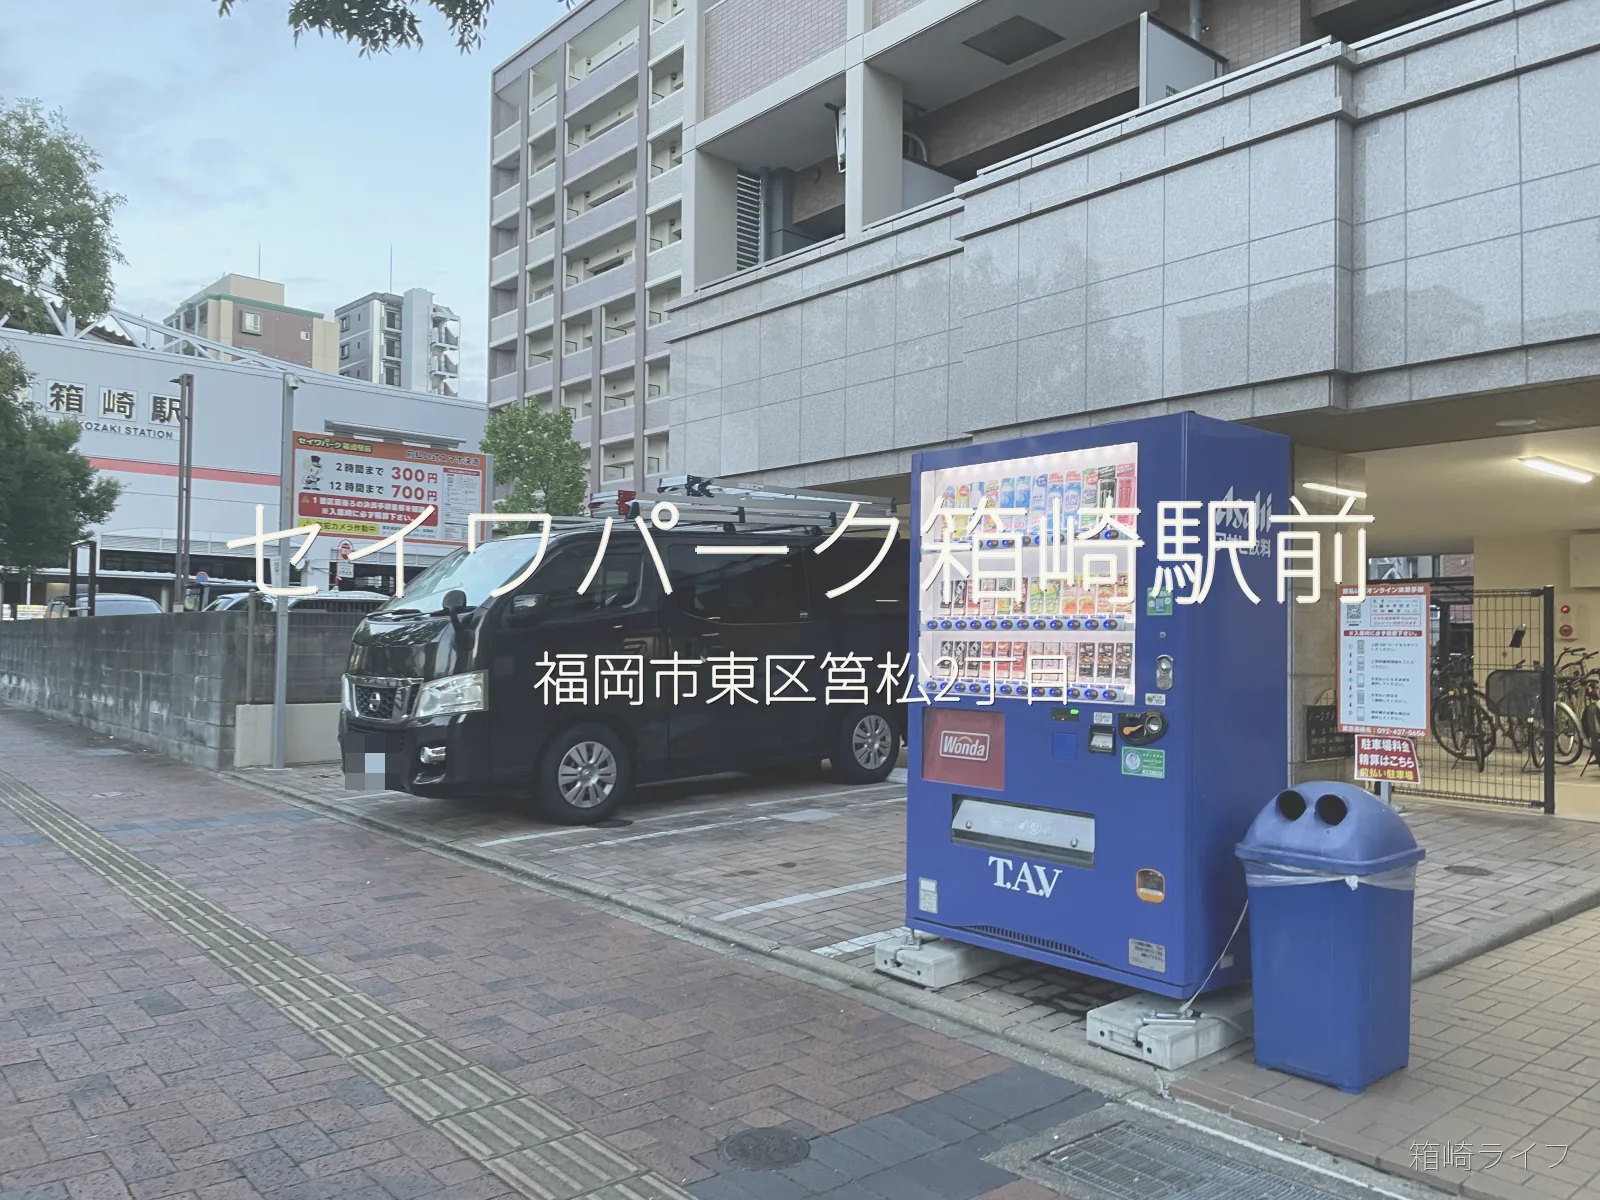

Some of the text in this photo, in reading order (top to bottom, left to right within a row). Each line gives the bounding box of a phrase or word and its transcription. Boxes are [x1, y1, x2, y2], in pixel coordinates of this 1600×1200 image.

[50, 382, 181, 423] 箱崎駅
[124, 426, 173, 439] STATION
[336, 462, 384, 476] 2時間まで
[391, 466, 438, 484] 300円
[329, 481, 437, 502] 12時間まで 700円
[942, 735, 986, 757] Wonda
[1361, 738, 1411, 753] 駐車場料金
[1359, 753, 1415, 768] 精算はこちら
[1360, 767, 1414, 780] 前払い駐車場
